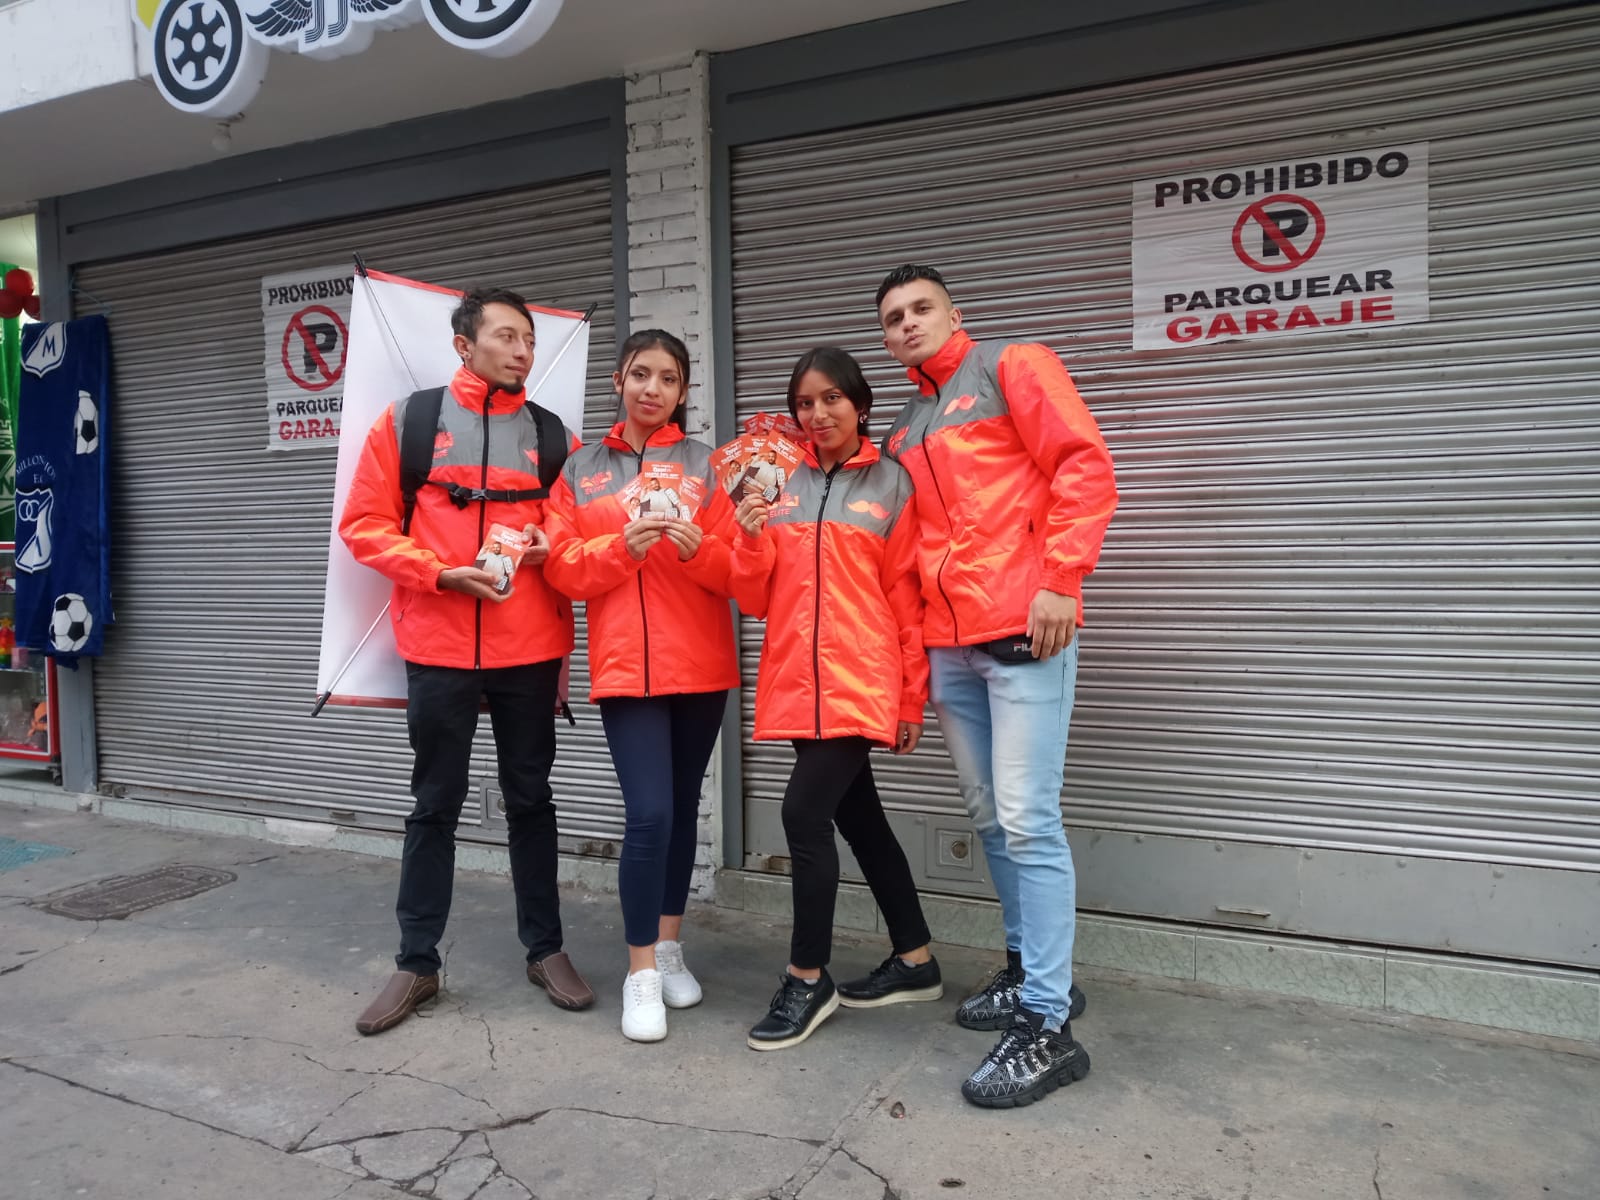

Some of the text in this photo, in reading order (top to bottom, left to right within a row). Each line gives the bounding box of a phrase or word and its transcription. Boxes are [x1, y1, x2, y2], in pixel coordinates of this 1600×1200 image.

[1154, 151, 1409, 208] PROHIBIDO
[1262, 208, 1309, 258] P
[1164, 269, 1395, 314] PARQUEAR
[1166, 296, 1395, 343] GARAJE
[42, 335, 56, 358] M
[303, 322, 338, 374] P
[276, 397, 344, 417] PARQUE
[279, 417, 340, 441] GARA
[1013, 642, 1033, 652] FIL
